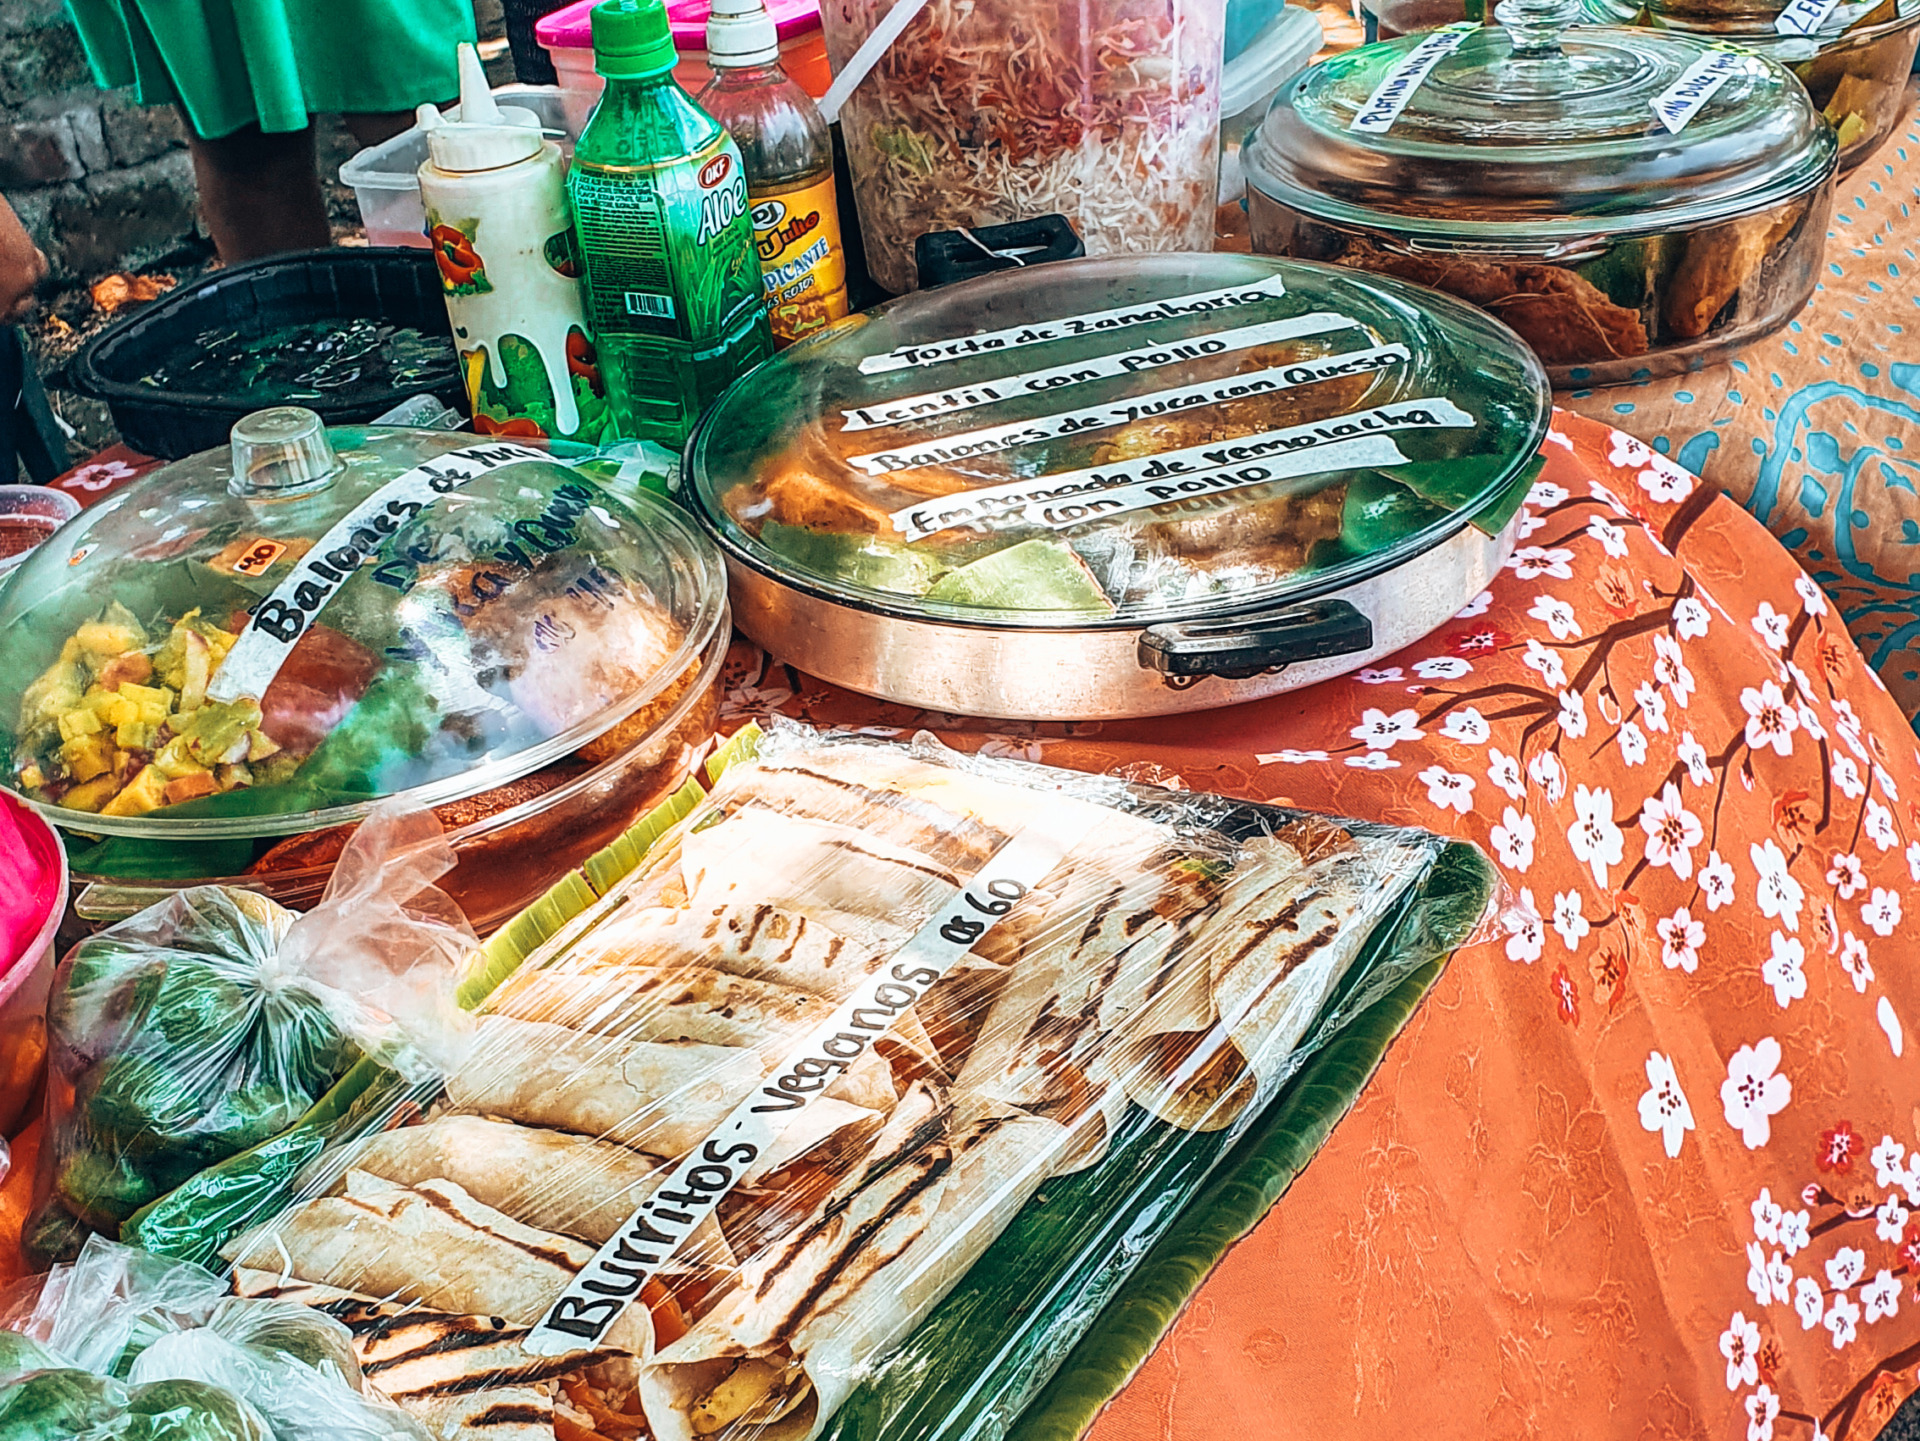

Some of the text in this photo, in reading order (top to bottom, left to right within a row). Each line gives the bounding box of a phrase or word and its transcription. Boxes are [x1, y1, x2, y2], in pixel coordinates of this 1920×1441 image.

[705, 158, 726, 184] OKF
[697, 176, 747, 246] Aloe
[751, 203, 779, 224] DJ
[762, 236, 829, 292] PICANTE
[783, 274, 815, 301] ROJOS
[890, 289, 1280, 365] Torta de Zanahoria
[855, 339, 1227, 426] Lentil con Pollo
[871, 352, 1405, 472] Balones de Yuca con Queso
[1141, 460, 1196, 478] de
[247, 500, 423, 644] Balones
[418, 466, 472, 493] de
[543, 1138, 759, 1343] Burritos
[965, 879, 1028, 916] 60
